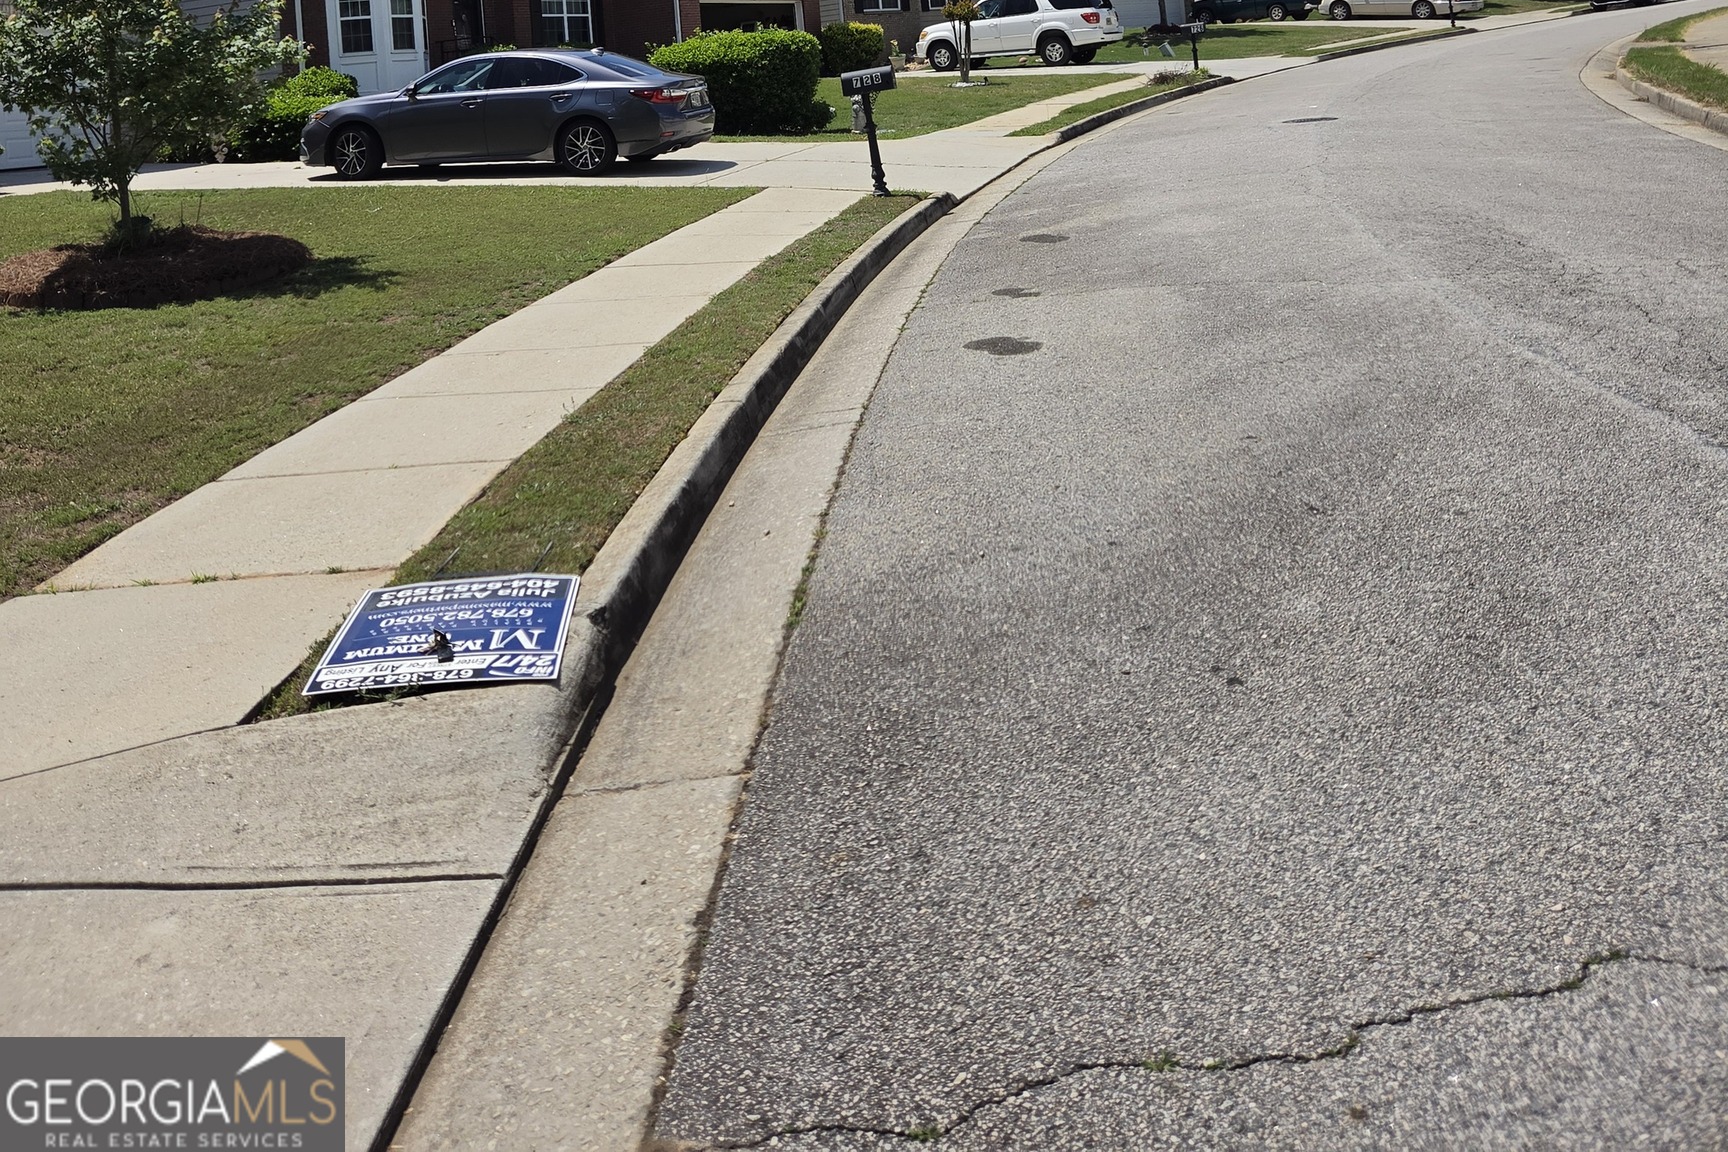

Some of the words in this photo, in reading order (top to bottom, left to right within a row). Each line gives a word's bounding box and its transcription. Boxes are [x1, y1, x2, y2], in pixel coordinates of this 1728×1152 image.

[853, 73, 881, 88] 728
[376, 590, 492, 607] Azubuike
[497, 588, 556, 598] Julia
[379, 608, 533, 627] 678.782.5050
[491, 654, 556, 667] 24/7
[325, 667, 364, 676] Listing
[369, 664, 402, 673] Any
[514, 666, 553, 674] INFO
